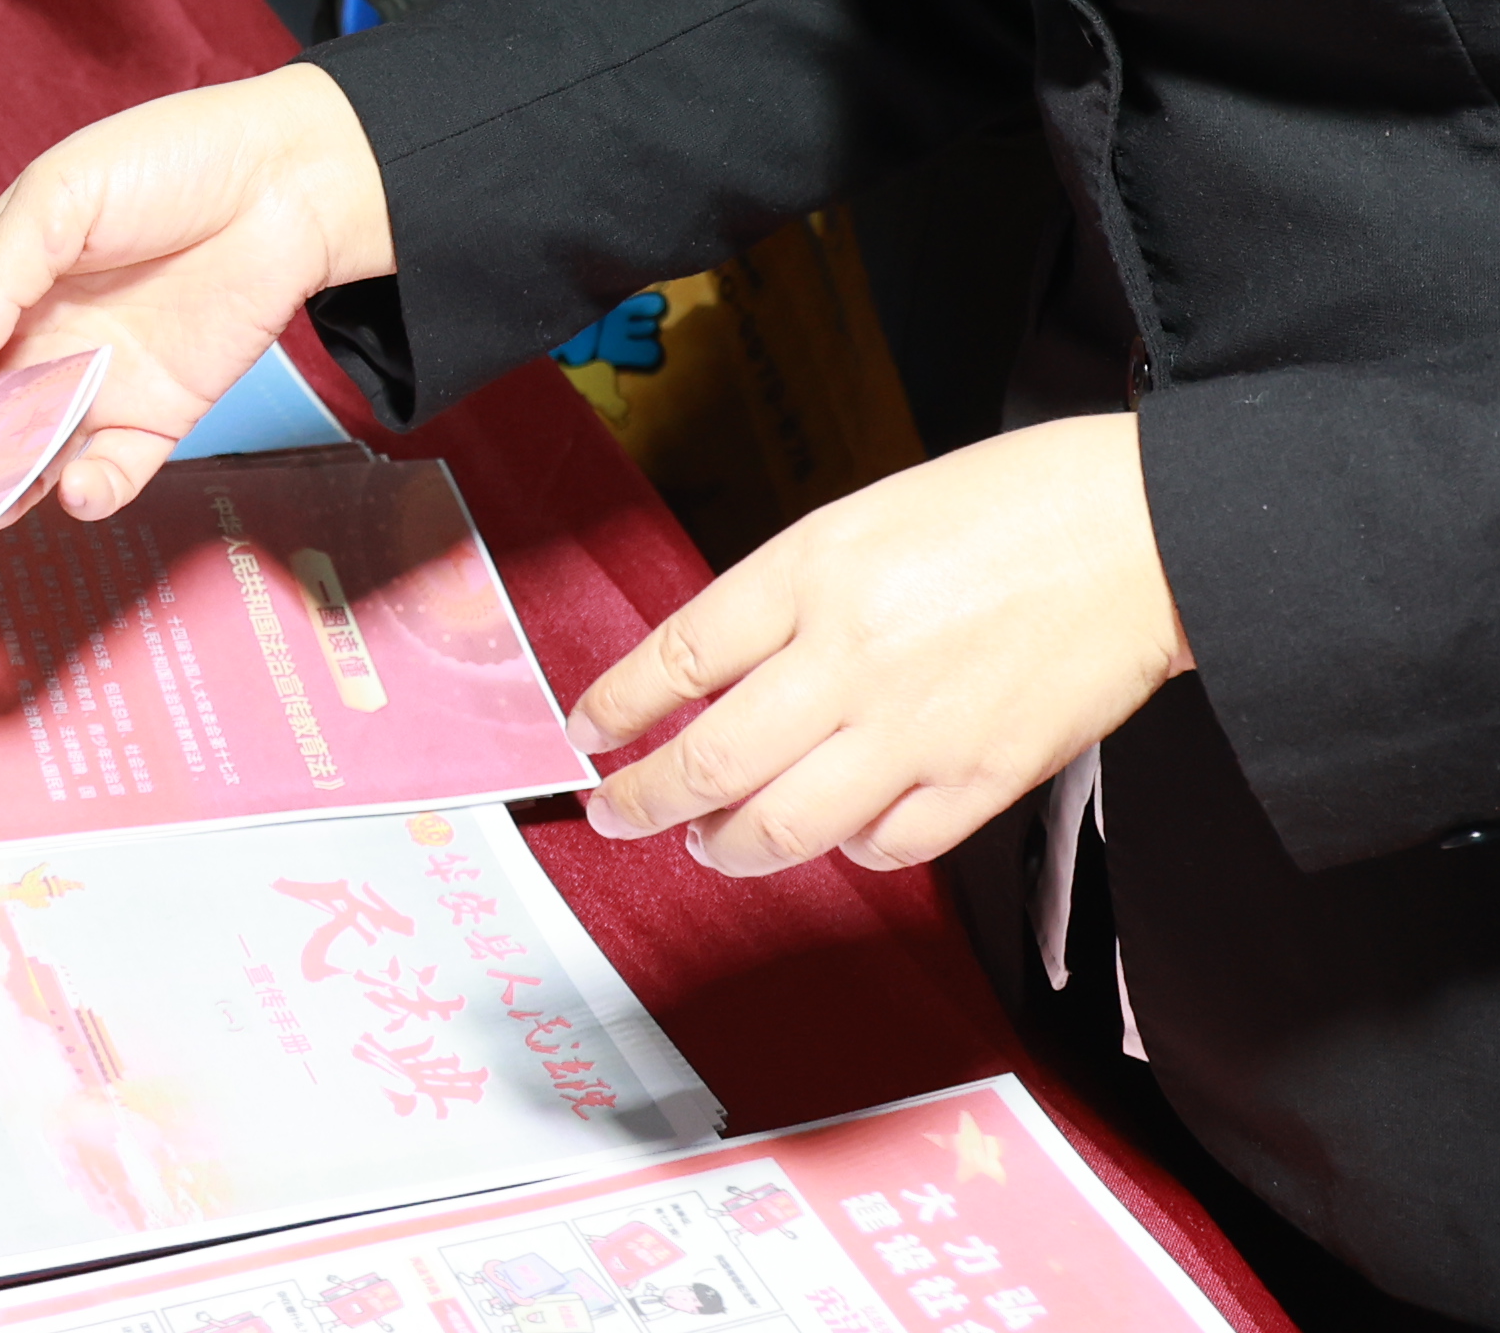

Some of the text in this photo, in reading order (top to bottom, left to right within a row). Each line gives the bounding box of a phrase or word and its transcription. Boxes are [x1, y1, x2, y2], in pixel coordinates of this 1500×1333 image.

[202, 484, 345, 794] 《中华人民共和国法治宣传教育法》
[316, 579, 371, 683] 一图读懂
[240, 962, 313, 1060] 宣传手册
[269, 875, 491, 1122] 民法典
[422, 851, 621, 1123] 华安县人民法院
[899, 1183, 1048, 1331] 大力弘
